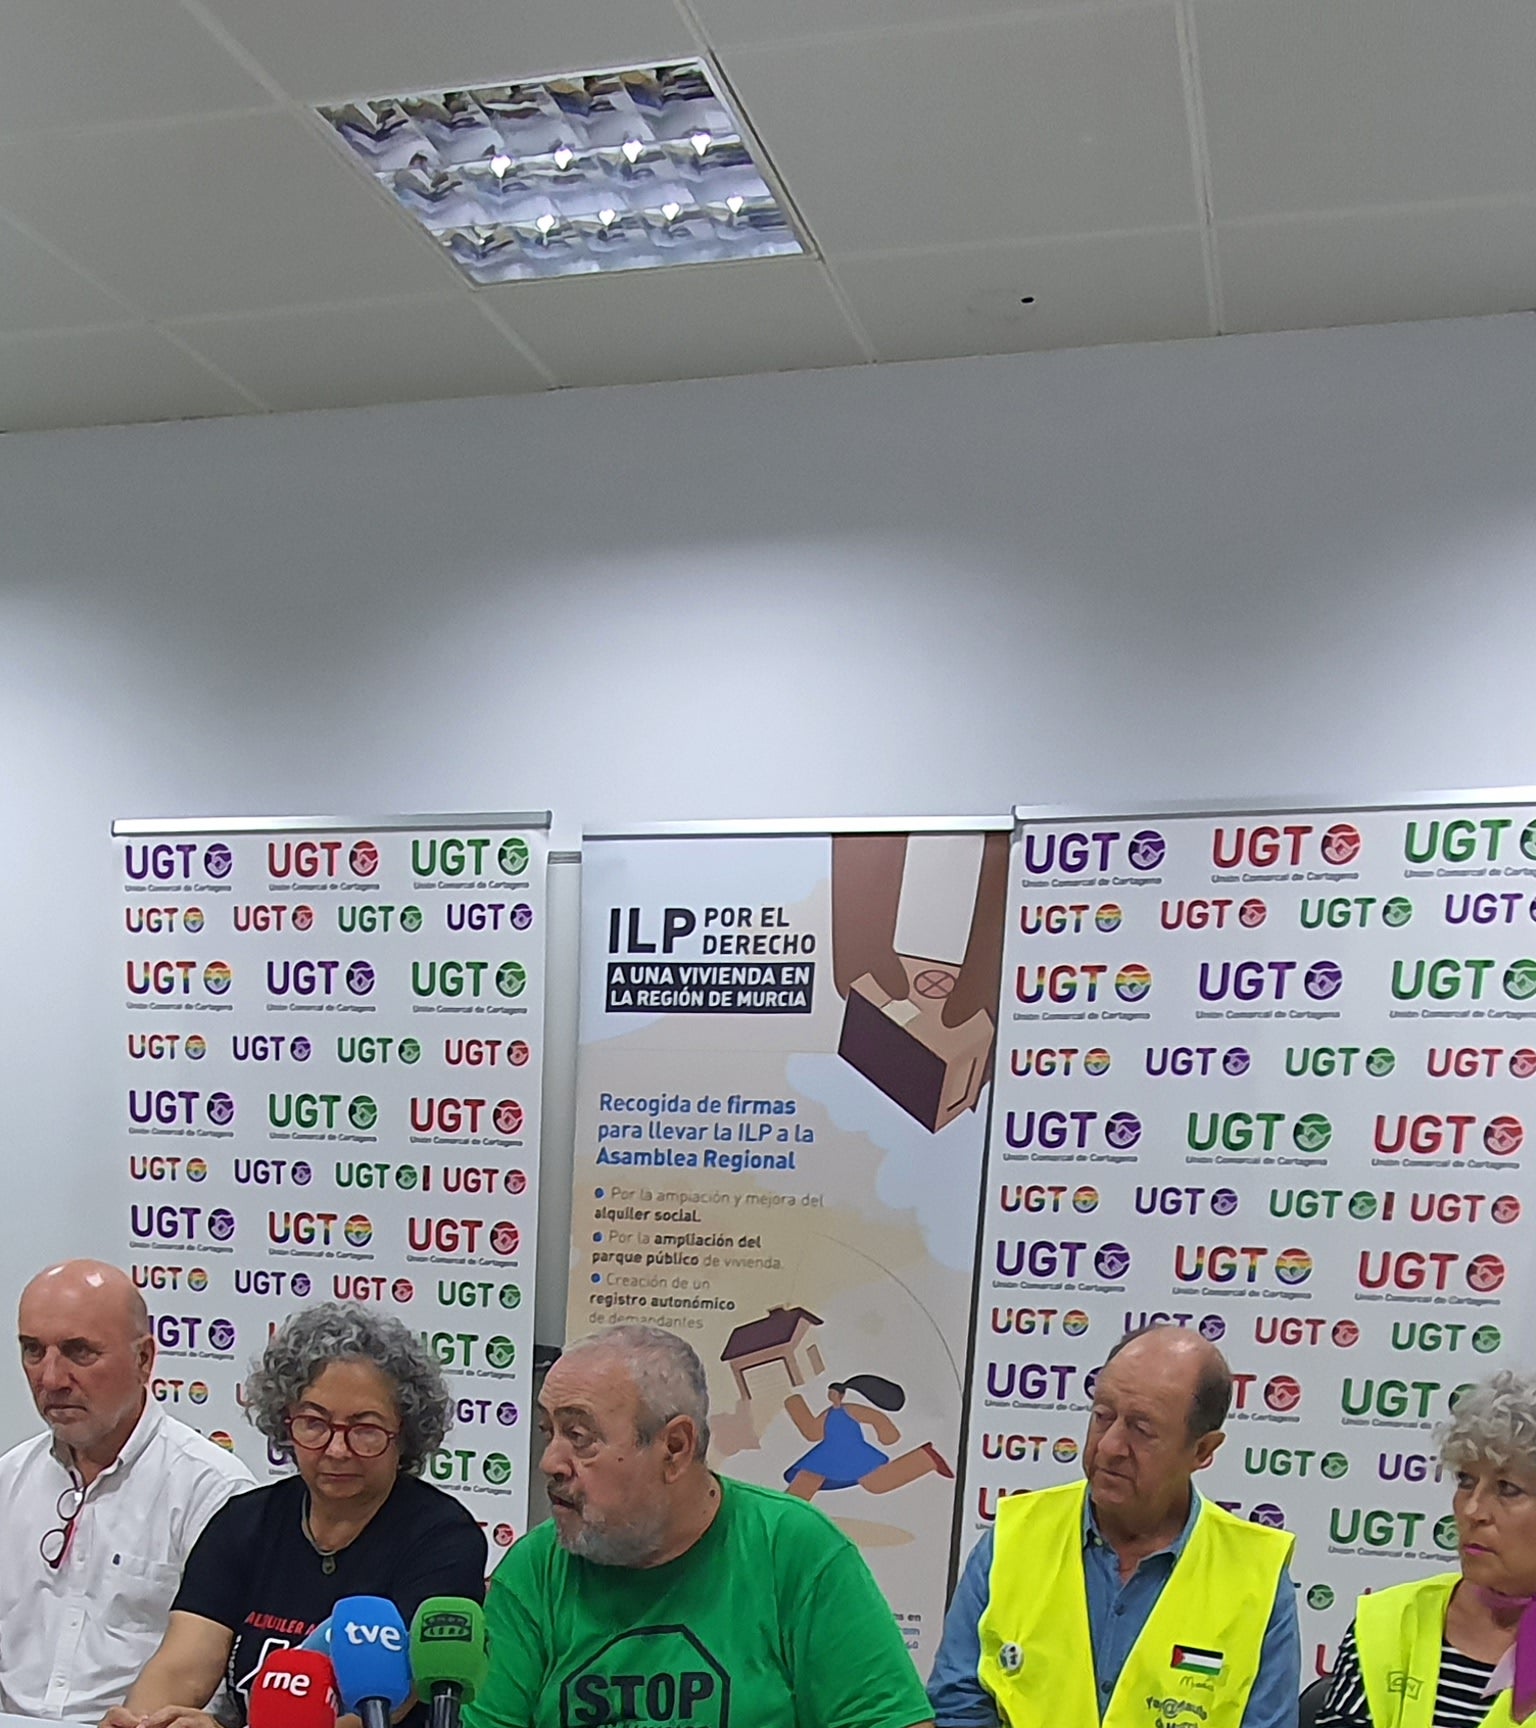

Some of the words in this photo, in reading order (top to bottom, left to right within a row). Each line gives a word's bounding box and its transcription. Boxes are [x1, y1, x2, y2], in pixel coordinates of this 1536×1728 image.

[1025, 832, 1120, 874] UGT
[1213, 826, 1313, 868] UGT
[1404, 819, 1512, 864] UGT
[125, 844, 197, 880] UGT
[268, 842, 342, 878] UGT
[412, 839, 490, 877] UGT
[126, 907, 179, 933] UGT
[234, 905, 287, 931] UGT
[338, 905, 395, 933] UGT
[447, 903, 505, 931] UGT
[704, 907, 753, 928] POR
[761, 907, 790, 928] EL
[1021, 905, 1090, 934] UGT
[1161, 899, 1233, 930] UGT
[1300, 898, 1376, 929] UGT
[1445, 893, 1523, 924] UGT
[608, 907, 697, 954] ILP
[703, 934, 816, 955] DERECHO
[127, 961, 197, 994] UGT
[267, 960, 339, 995] UGT
[412, 961, 488, 997] UGT
[611, 966, 625, 985] A
[630, 966, 674, 985] UNA
[679, 966, 776, 985] VIVIENDA
[781, 966, 810, 985] EN
[1016, 965, 1107, 1003] UGT
[1199, 961, 1297, 1001] UGT
[1392, 959, 1495, 1000] UGT
[610, 990, 633, 1006] LA
[637, 986, 704, 1007] REGIÓN
[708, 990, 733, 1007] DE
[736, 990, 807, 1007] MURCIA
[128, 1034, 180, 1060] UGT
[233, 1036, 285, 1061] UGT
[338, 1037, 393, 1063] UGT
[445, 1039, 502, 1066] UGT
[1146, 1047, 1217, 1076] UGT
[1011, 1048, 1079, 1076] UGT
[1286, 1047, 1360, 1077] UGT
[1427, 1048, 1504, 1077] UGT
[129, 1090, 200, 1124] UGT
[269, 1094, 341, 1129] UGT
[411, 1097, 486, 1133] UGT
[600, 1093, 692, 1116] Recogida
[697, 1096, 721, 1113] de
[727, 1095, 796, 1115] firmas
[598, 1123, 642, 1142] para
[648, 1121, 709, 1141] llevar
[714, 1122, 732, 1141] la
[738, 1123, 773, 1142] ILP
[777, 1128, 789, 1142] a
[795, 1124, 814, 1143] la
[1006, 1111, 1097, 1149] UGT
[1188, 1112, 1285, 1151] UGT
[1374, 1115, 1476, 1154] UGT
[130, 1156, 181, 1181] UGT
[234, 1159, 287, 1185] UGT
[595, 1147, 698, 1167] Asamblea
[703, 1149, 796, 1172] Regional
[336, 1162, 390, 1189] UGT
[444, 1167, 499, 1193] UGT
[611, 1187, 634, 1200] Por
[745, 1193, 796, 1208] mejora
[801, 1194, 824, 1207] del
[1001, 1185, 1067, 1212] UGT
[1135, 1187, 1205, 1215] UGT
[1270, 1189, 1343, 1218] UGT
[1411, 1193, 1486, 1223] UGT
[131, 1205, 201, 1239] UGT
[269, 1211, 338, 1245] UGT
[594, 1207, 651, 1223] alquiler
[409, 1217, 483, 1253] UGT
[608, 1230, 633, 1244] Por
[637, 1231, 650, 1244] la
[654, 1232, 734, 1249] ampliación
[738, 1235, 761, 1249] del
[592, 1251, 642, 1266] parque
[646, 1250, 700, 1267] público
[703, 1254, 720, 1267] de
[996, 1240, 1087, 1278] UGT
[1175, 1245, 1268, 1282] UGT
[1359, 1251, 1459, 1290] UGT
[132, 1265, 181, 1290] UGT
[235, 1270, 287, 1296] UGT
[334, 1275, 387, 1301] UGT
[606, 1272, 668, 1288] Creación
[671, 1275, 688, 1289] de
[693, 1279, 710, 1290] un
[438, 1280, 494, 1307] UGT
[589, 1292, 647, 1308] registro
[651, 1296, 736, 1311] autonómico
[589, 1311, 605, 1324] de
[992, 1307, 1058, 1335] UGT
[1255, 1317, 1326, 1345] UGT
[1392, 1322, 1466, 1351] UGT
[987, 1362, 1076, 1400] UGT
[1341, 1378, 1441, 1418] UGT
[983, 1433, 1047, 1462] UGT
[1245, 1447, 1316, 1477] UGT
[1330, 1508, 1425, 1548] UGT
[344, 1621, 404, 1651] tve
[262, 1671, 311, 1697] rne
[574, 1671, 714, 1723] STOP
